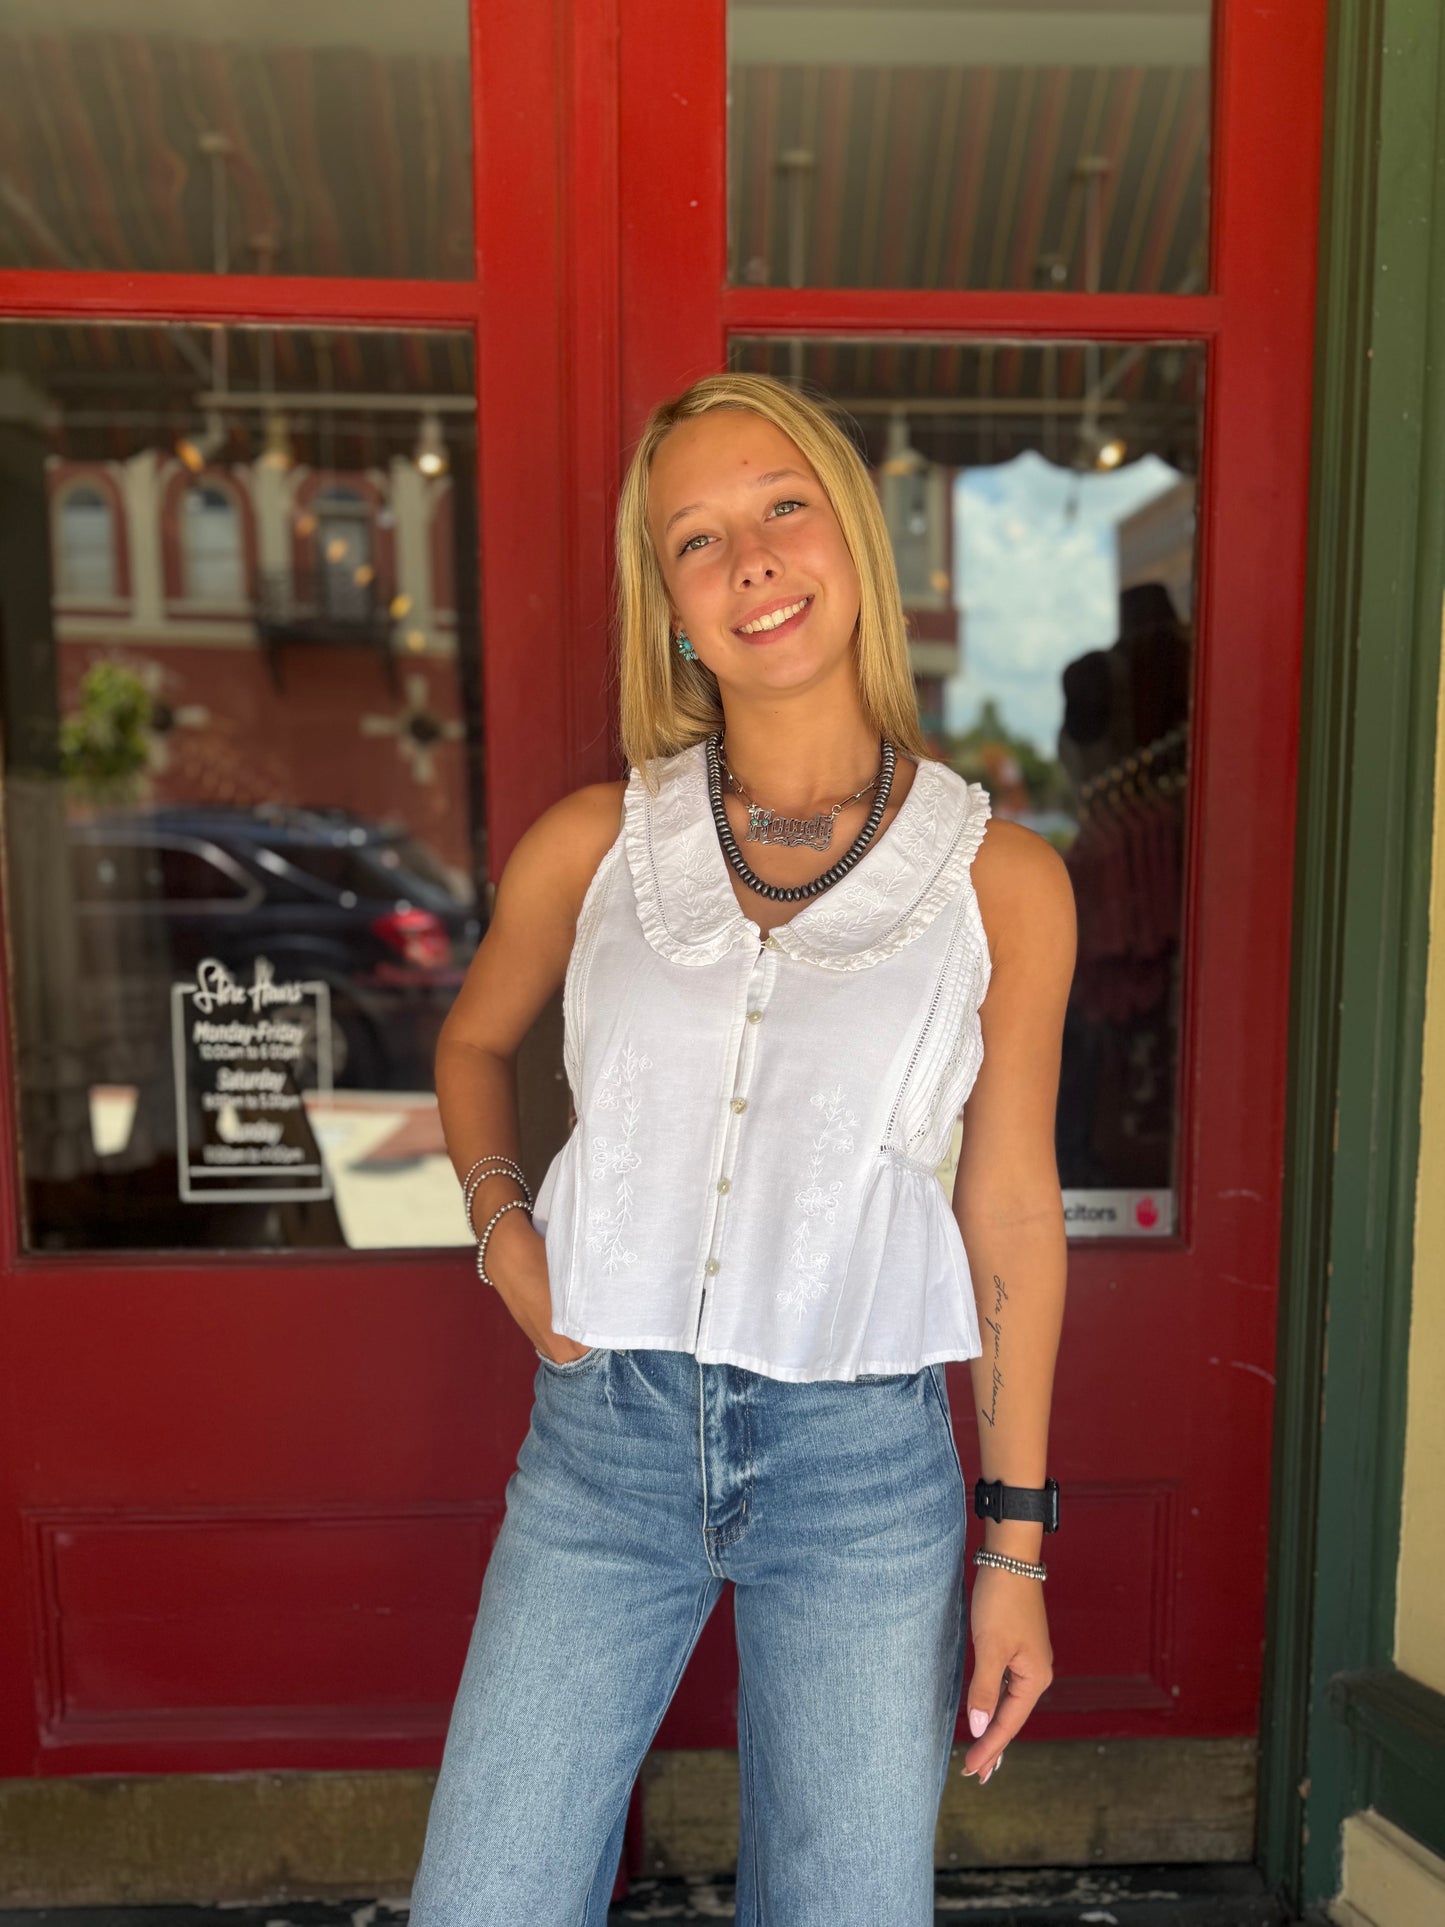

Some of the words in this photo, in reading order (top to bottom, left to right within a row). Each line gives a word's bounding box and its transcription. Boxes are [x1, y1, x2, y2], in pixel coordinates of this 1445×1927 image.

[746, 808, 836, 851] Howdy
[193, 959, 246, 1014] Store
[248, 957, 302, 1013] Hours
[216, 1067, 286, 1093] Saturday
[217, 1118, 283, 1147] unday
[1063, 1203, 1117, 1222] citors
[993, 1274, 1009, 1314] Love
